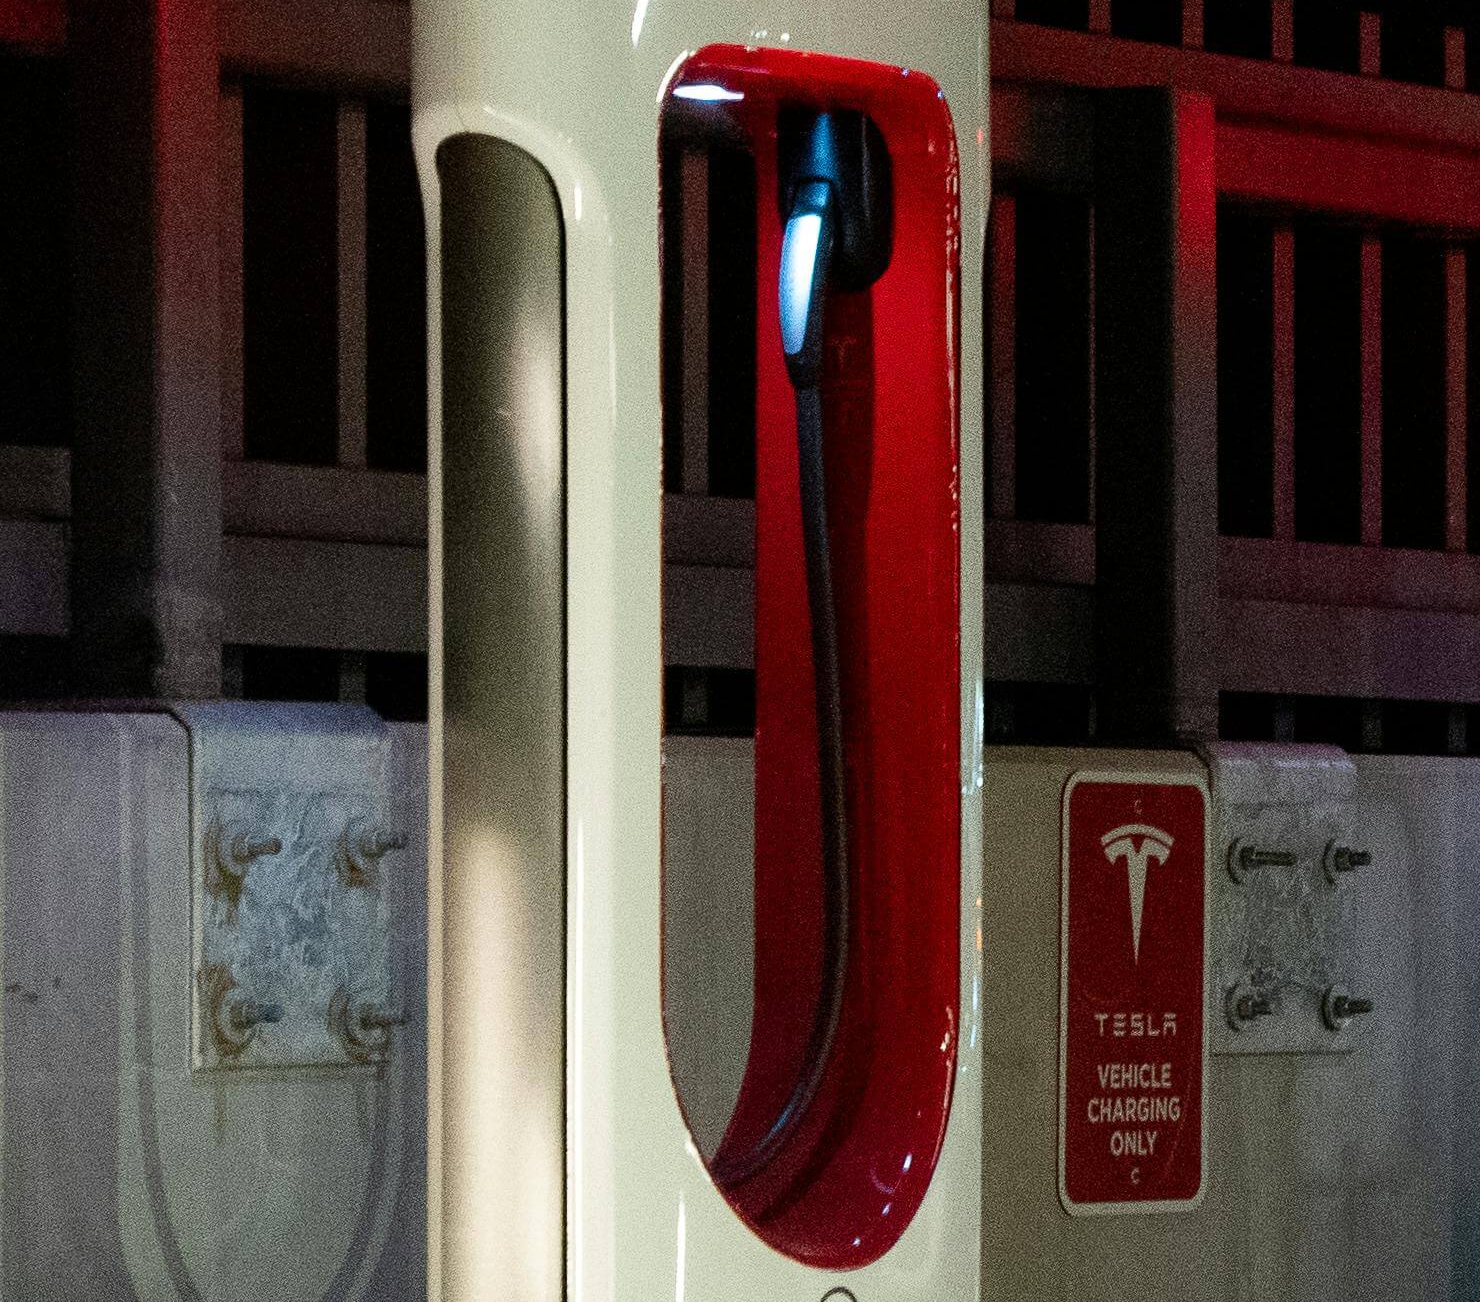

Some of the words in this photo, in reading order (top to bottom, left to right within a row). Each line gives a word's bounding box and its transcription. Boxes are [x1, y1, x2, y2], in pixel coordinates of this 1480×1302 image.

[1094, 1012, 1177, 1038] TESLA
[1097, 1062, 1172, 1089] VEHICLE
[1087, 1096, 1181, 1124] CHARGING
[1110, 1130, 1158, 1157] ONLY
